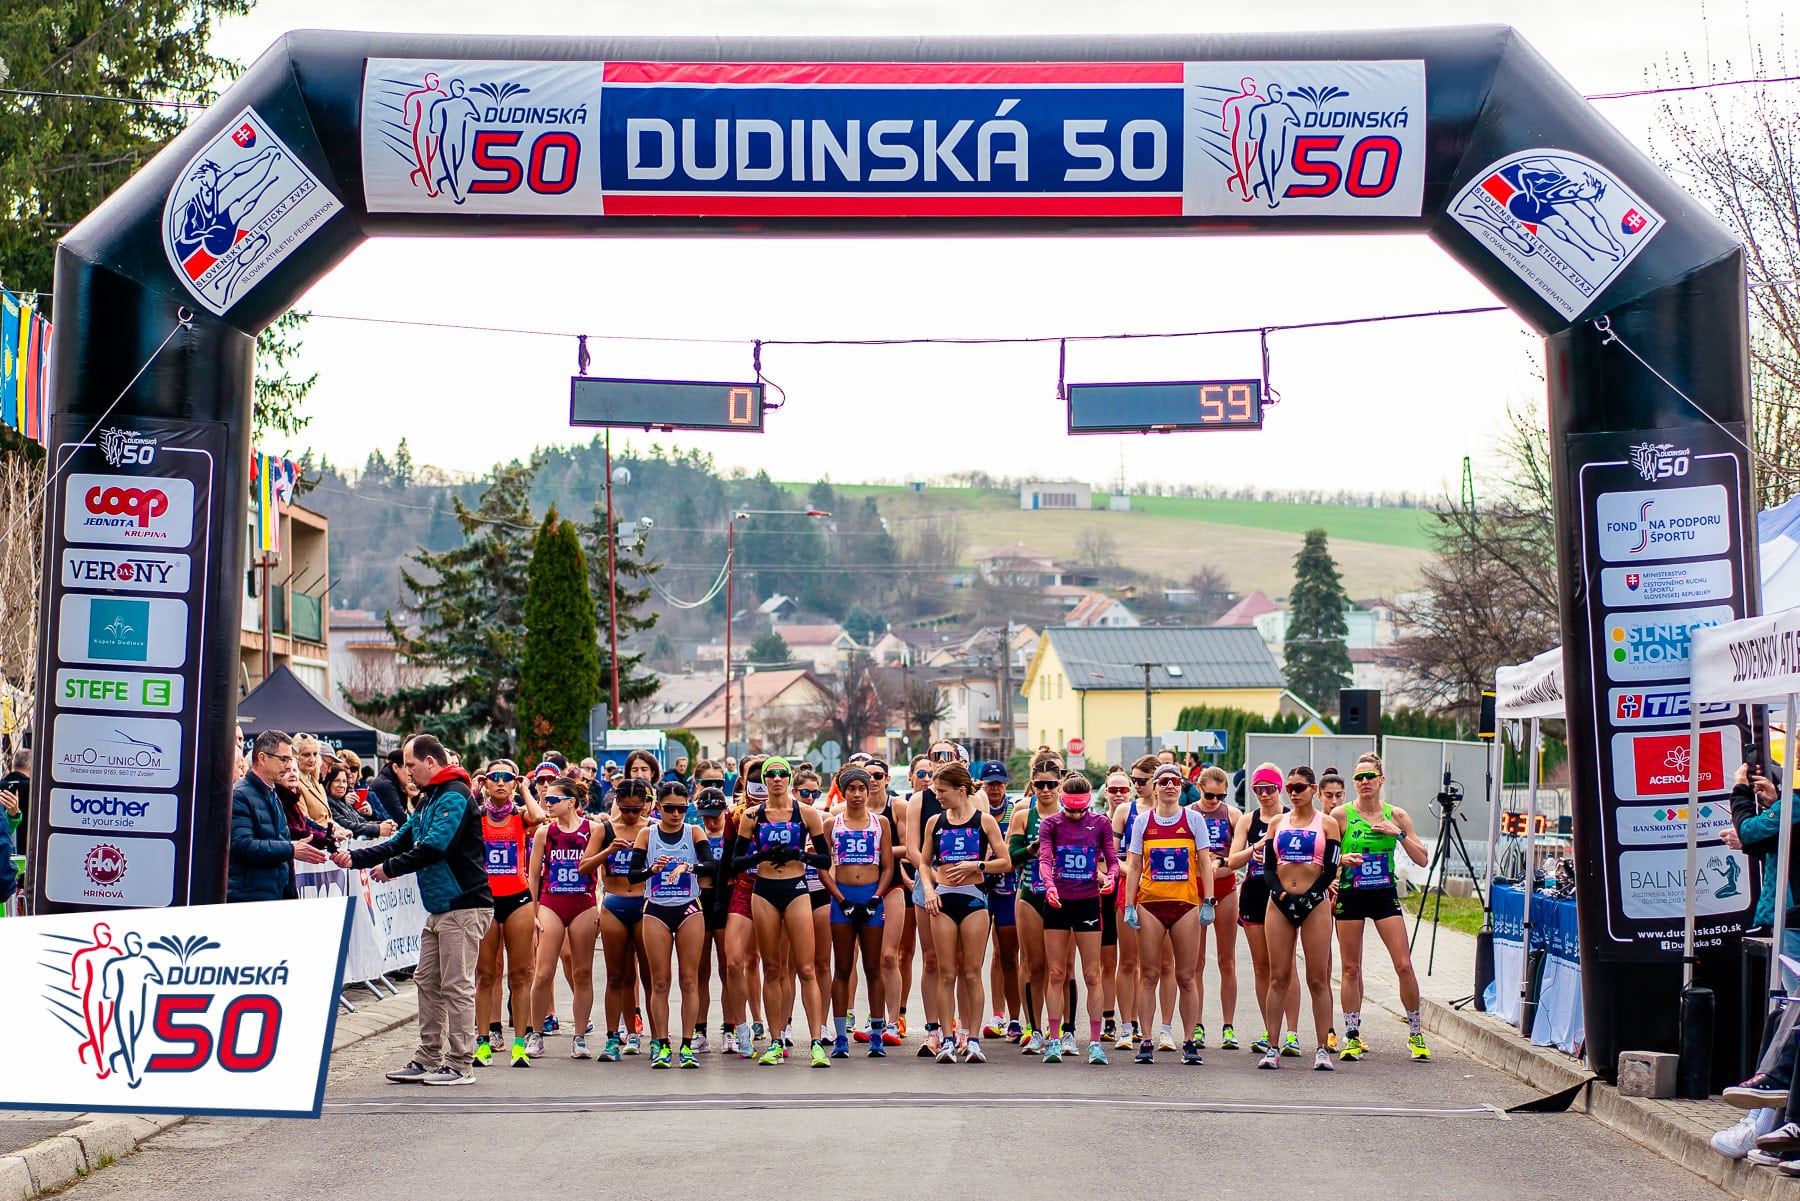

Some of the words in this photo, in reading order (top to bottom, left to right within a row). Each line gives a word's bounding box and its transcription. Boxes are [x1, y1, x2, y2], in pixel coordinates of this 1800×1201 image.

[484, 104, 587, 125] DUDINSKÁ
[1304, 106, 1409, 129] DUDINSKÁ
[627, 98, 1029, 182] DUDINSKÁ
[1063, 119, 1168, 182] 50
[468, 130, 581, 195] 50
[1283, 135, 1402, 198] 50
[241, 260, 267, 285] SLOVAK
[264, 235, 295, 265] ATHLETIC
[292, 201, 334, 239] FEDERATION
[1482, 230, 1507, 254] SLOVAK
[1505, 252, 1537, 280] ATHLETIC
[1534, 277, 1575, 314] FEDERATION
[728, 386, 752, 424] 0
[1199, 383, 1252, 423] 59
[121, 445, 155, 465] 50
[1657, 457, 1689, 478] 50
[83, 517, 134, 528] JEDNOTA
[1606, 521, 1638, 533] FOND
[1649, 520, 1665, 530] NA
[1669, 515, 1721, 529] PODPORU
[124, 530, 168, 539] KRUPINA
[1650, 530, 1695, 543] ŠPORTU
[1642, 570, 1687, 579] MINISTERSTVO
[65, 678, 129, 701] STEFE
[108, 750, 161, 768] UNICOM
[1649, 774, 1691, 785] ACEROL
[70, 794, 150, 817] brother
[82, 817, 90, 825] at
[92, 818, 114, 827] your
[114, 817, 134, 827] side
[1633, 818, 1712, 833] BANSKOBYSTCKÝ
[767, 829, 791, 844] 49
[953, 836, 965, 851] 5
[1289, 836, 1302, 850] 4
[846, 838, 867, 853] 36
[488, 849, 509, 864] 61
[550, 849, 585, 861] POLIZIA
[1064, 854, 1087, 869] 50
[1163, 855, 1175, 870] 6
[557, 868, 579, 882] 86
[1361, 861, 1382, 875] 65
[83, 889, 124, 899] HRIŇOVÁ
[1710, 938, 1722, 946] 50
